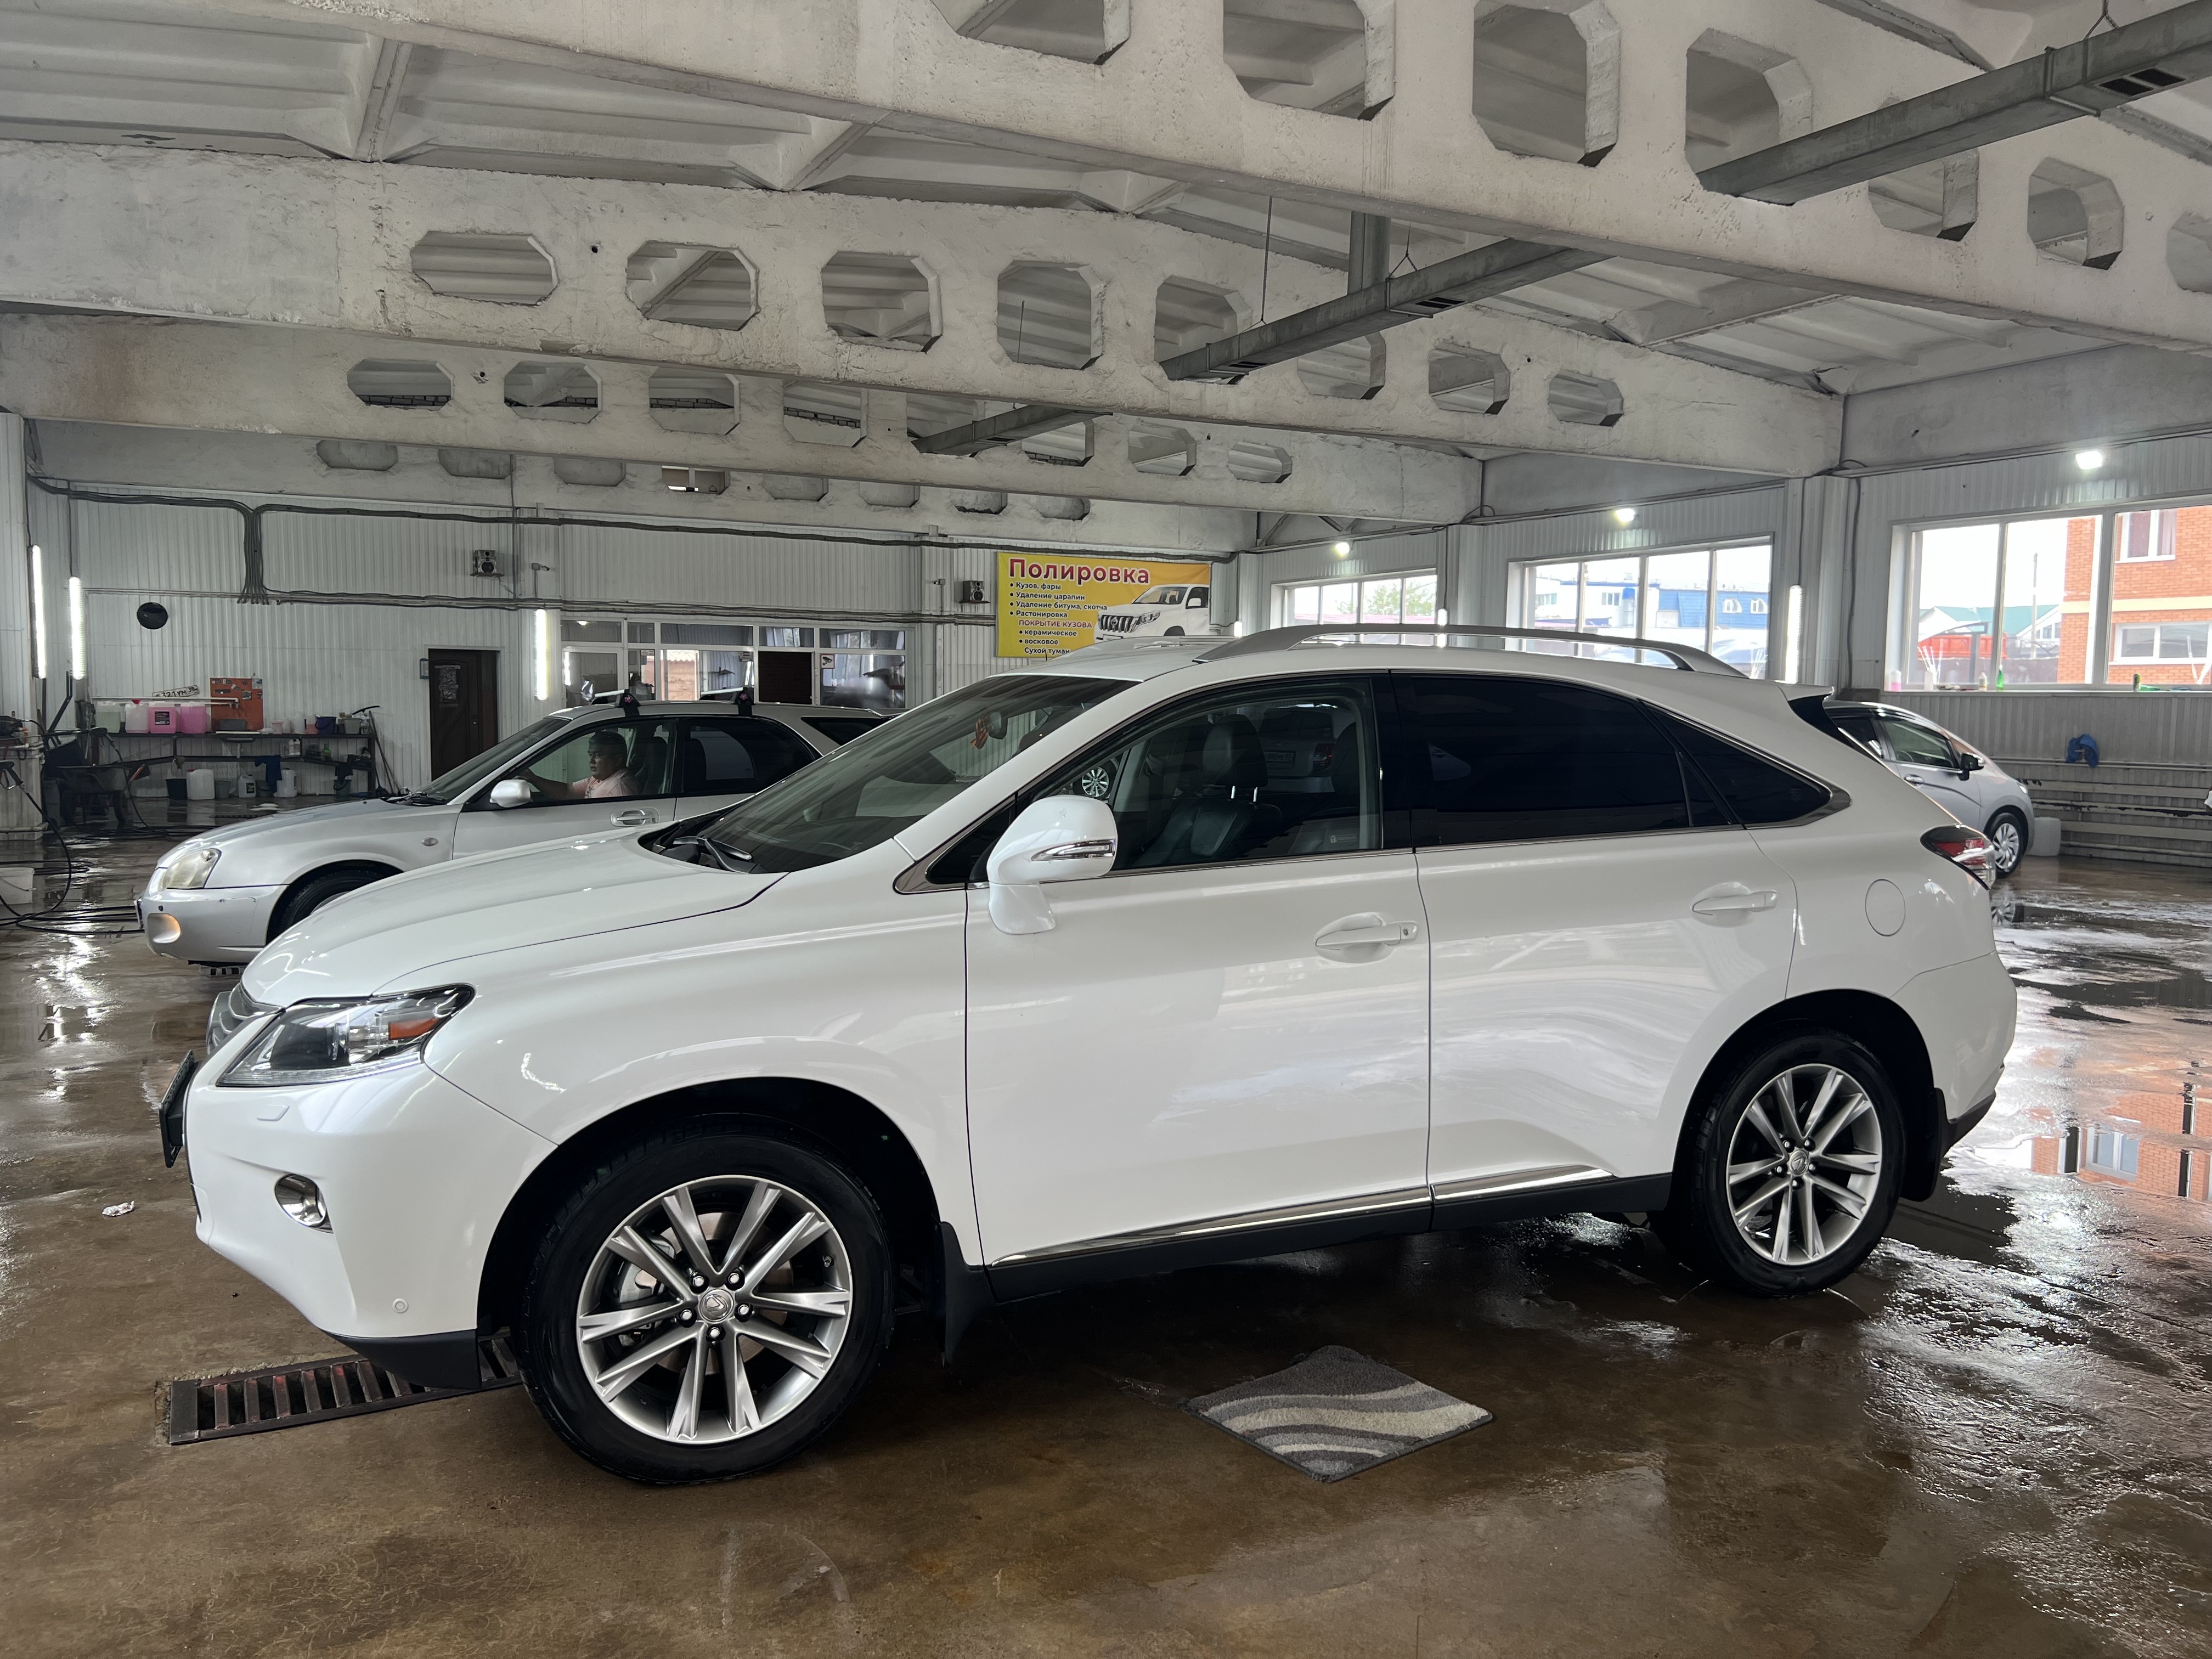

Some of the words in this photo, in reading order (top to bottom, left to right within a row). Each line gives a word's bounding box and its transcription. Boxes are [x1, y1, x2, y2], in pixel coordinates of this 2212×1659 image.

[1009, 558, 1149, 585] Полировка
[1016, 582, 1039, 590] Кузов,
[1041, 583, 1061, 591] фары
[1015, 591, 1052, 600] Удаление
[1054, 602, 1082, 611] битума,
[1015, 610, 1068, 619] Растонировка
